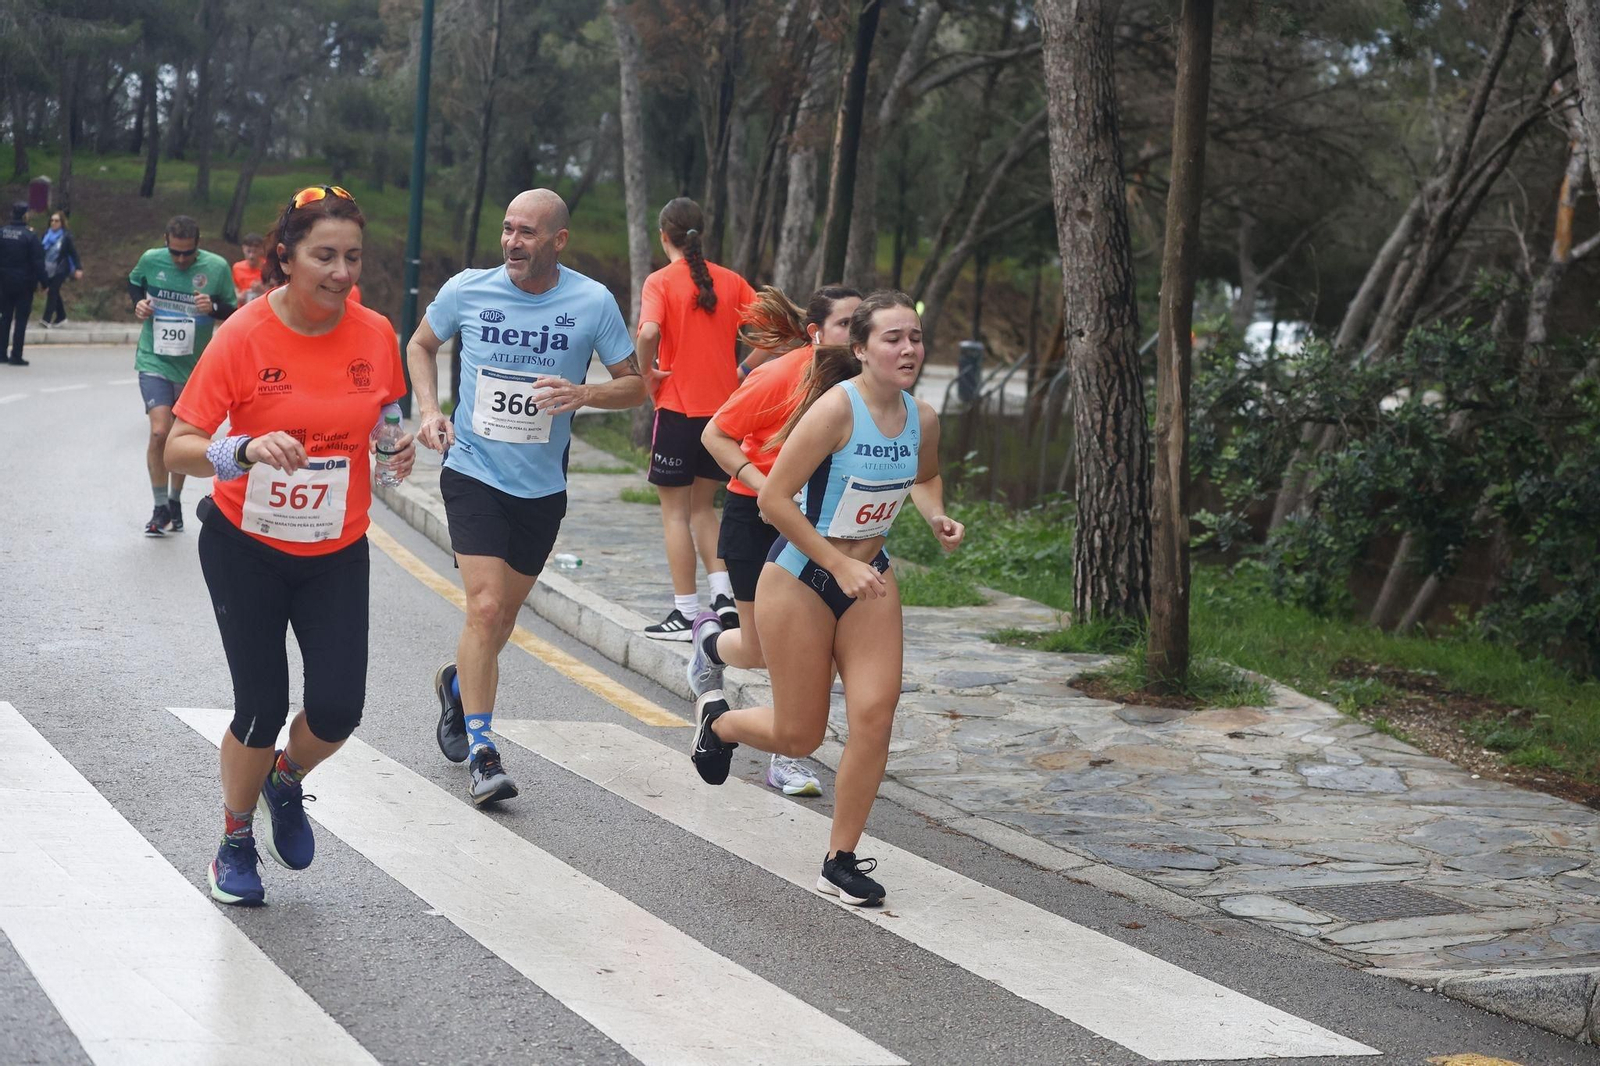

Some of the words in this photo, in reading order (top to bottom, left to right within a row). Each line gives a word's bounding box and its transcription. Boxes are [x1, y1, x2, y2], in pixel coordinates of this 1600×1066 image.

[157, 289, 196, 303] ATLETISM
[481, 310, 504, 322] TROPS
[161, 328, 186, 341] 290
[480, 325, 569, 354] nerja
[490, 352, 555, 367] ATLETISMO
[258, 384, 292, 392] HYUNDAI
[491, 390, 539, 417] 366
[312, 432, 349, 442] Ciudad
[311, 444, 323, 453] de
[854, 441, 911, 462] nerja
[861, 462, 906, 470] ATLETISMO
[269, 481, 328, 510] 567
[855, 500, 897, 525] 641
